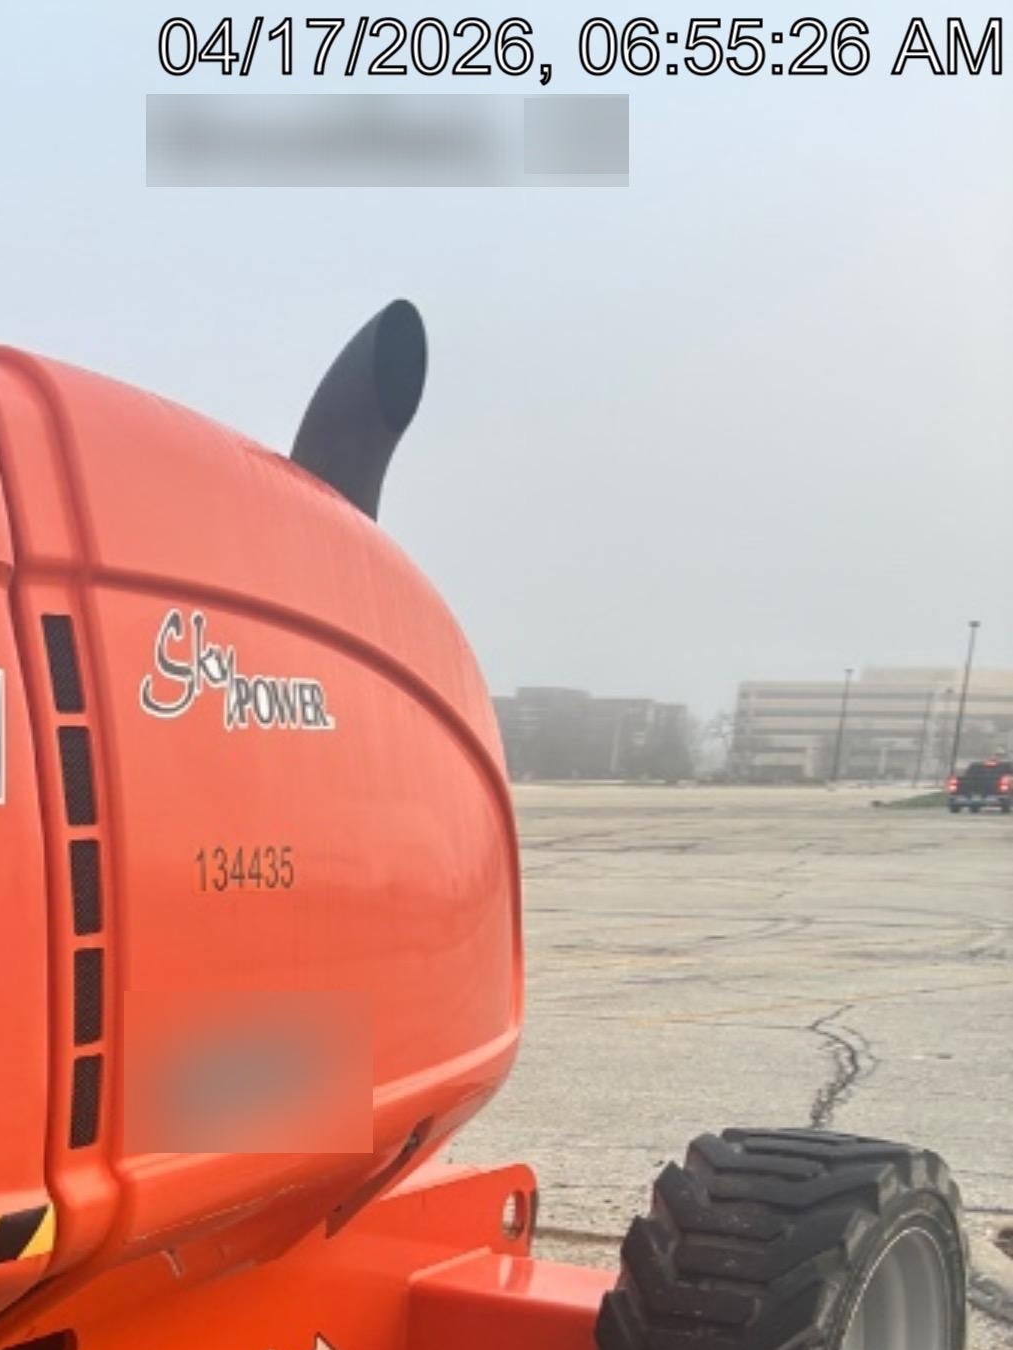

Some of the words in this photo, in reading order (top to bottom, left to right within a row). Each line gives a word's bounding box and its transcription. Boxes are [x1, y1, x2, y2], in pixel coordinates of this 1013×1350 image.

[140, 608, 236, 731] Sky
[231, 675, 335, 731] POWER
[196, 846, 294, 892] 134435
